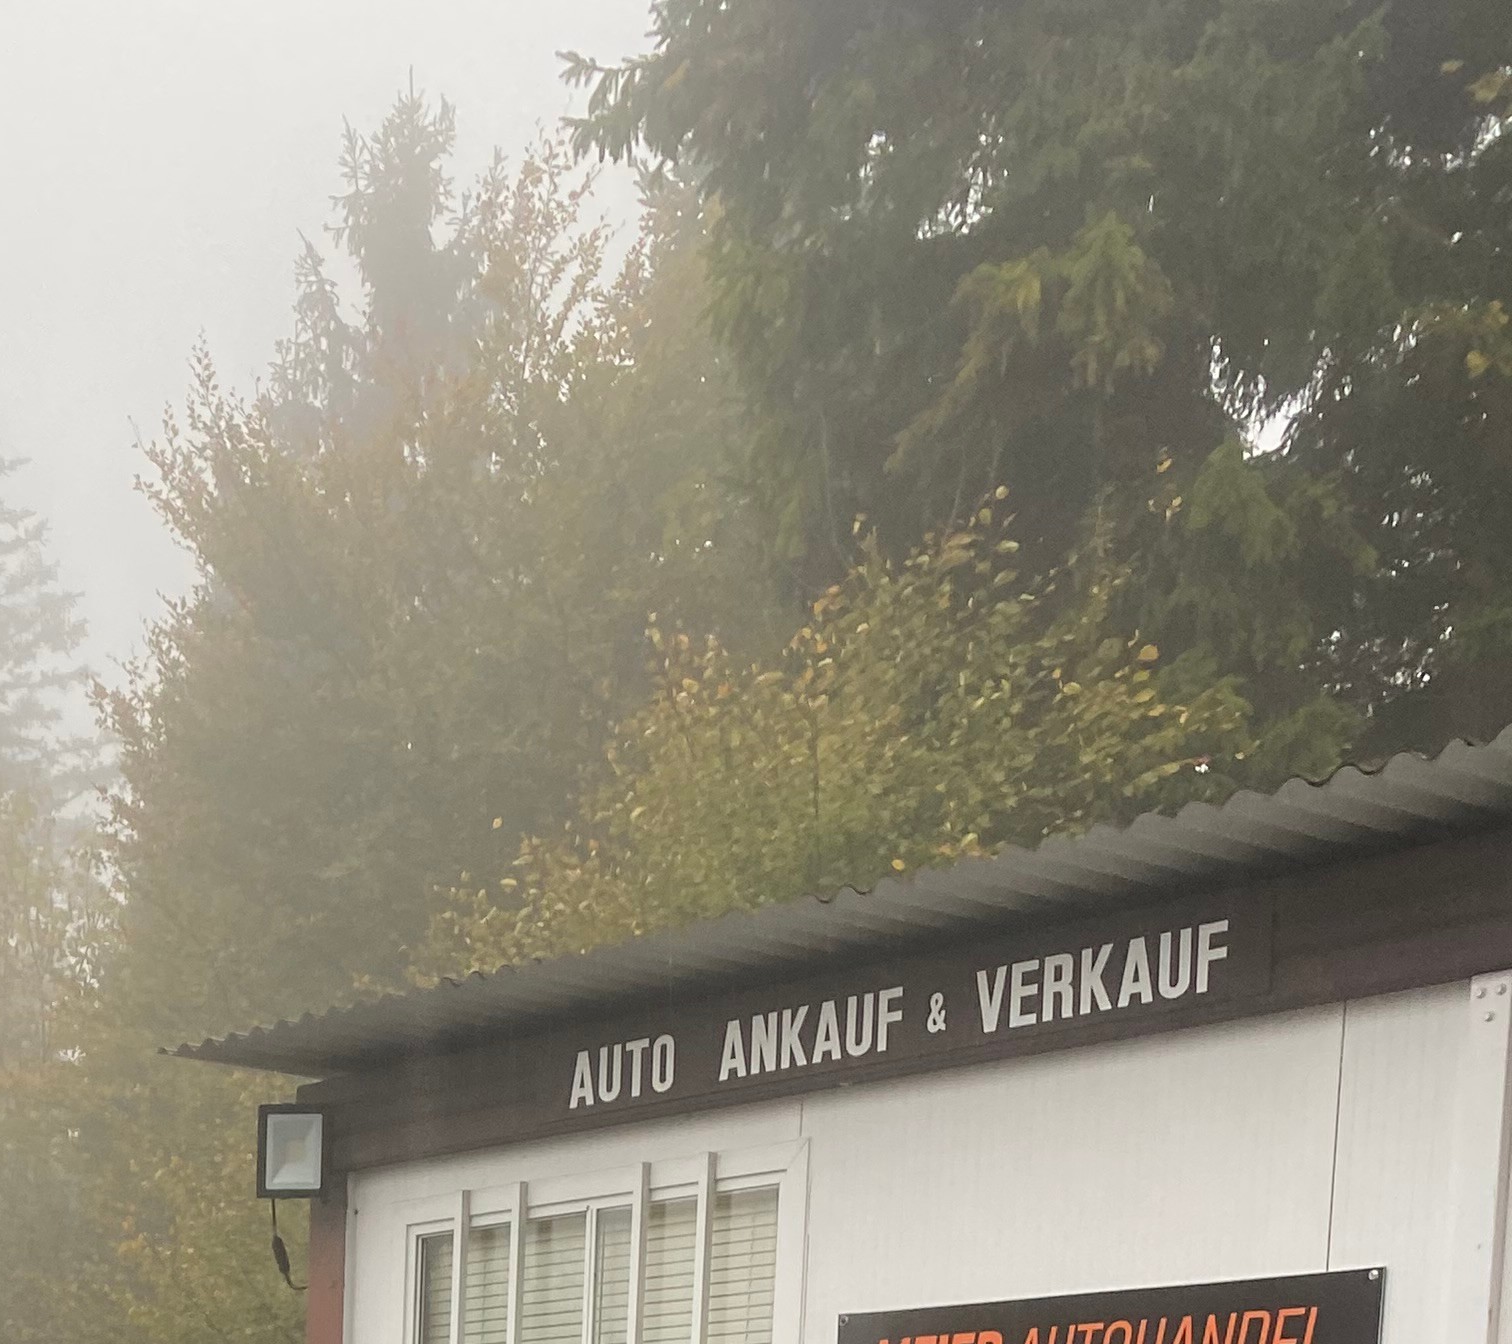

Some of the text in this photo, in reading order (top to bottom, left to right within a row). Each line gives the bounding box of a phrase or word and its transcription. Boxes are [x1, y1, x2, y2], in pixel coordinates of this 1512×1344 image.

[569, 919, 1230, 1109] AUTO ANKAUF & VERKAUF
